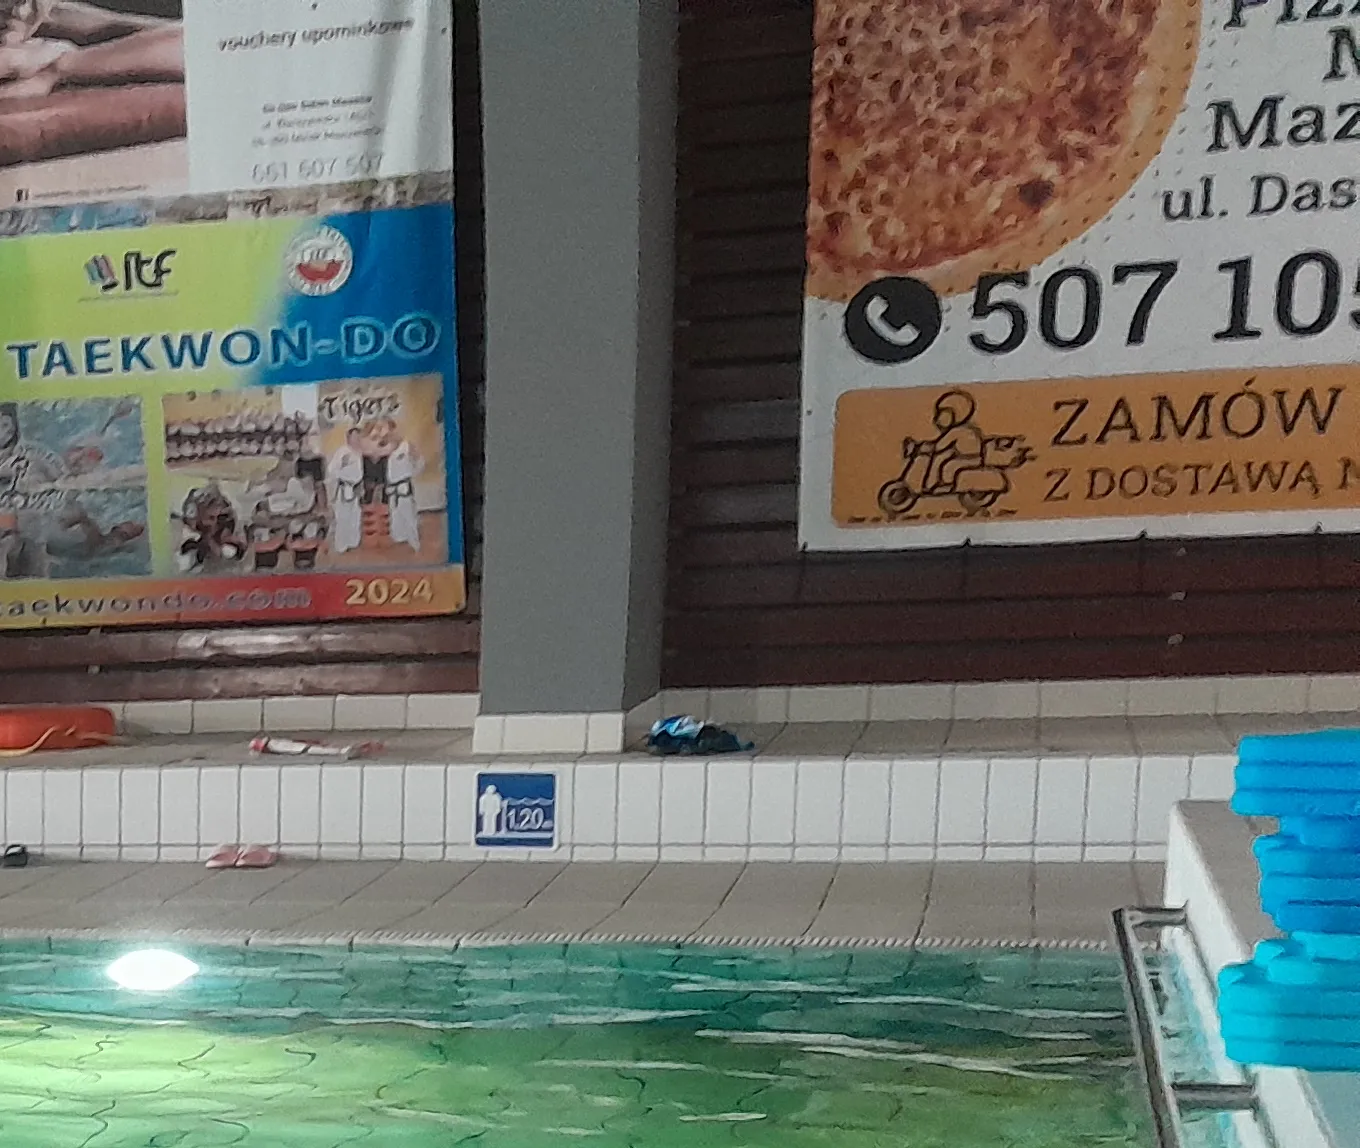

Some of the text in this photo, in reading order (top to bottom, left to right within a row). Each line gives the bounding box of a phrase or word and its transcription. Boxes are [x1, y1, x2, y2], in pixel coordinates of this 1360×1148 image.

[218, 29, 297, 51] vouchery
[1161, 174, 1229, 222] ul.
[969, 261, 1179, 355] 507
[6, 314, 440, 381] TAEKWON-DO
[1051, 377, 1346, 447] ZAMÓW
[1044, 467, 1072, 502] Z
[1085, 459, 1322, 501] DOSTAWĄ
[344, 578, 434, 606] 2024
